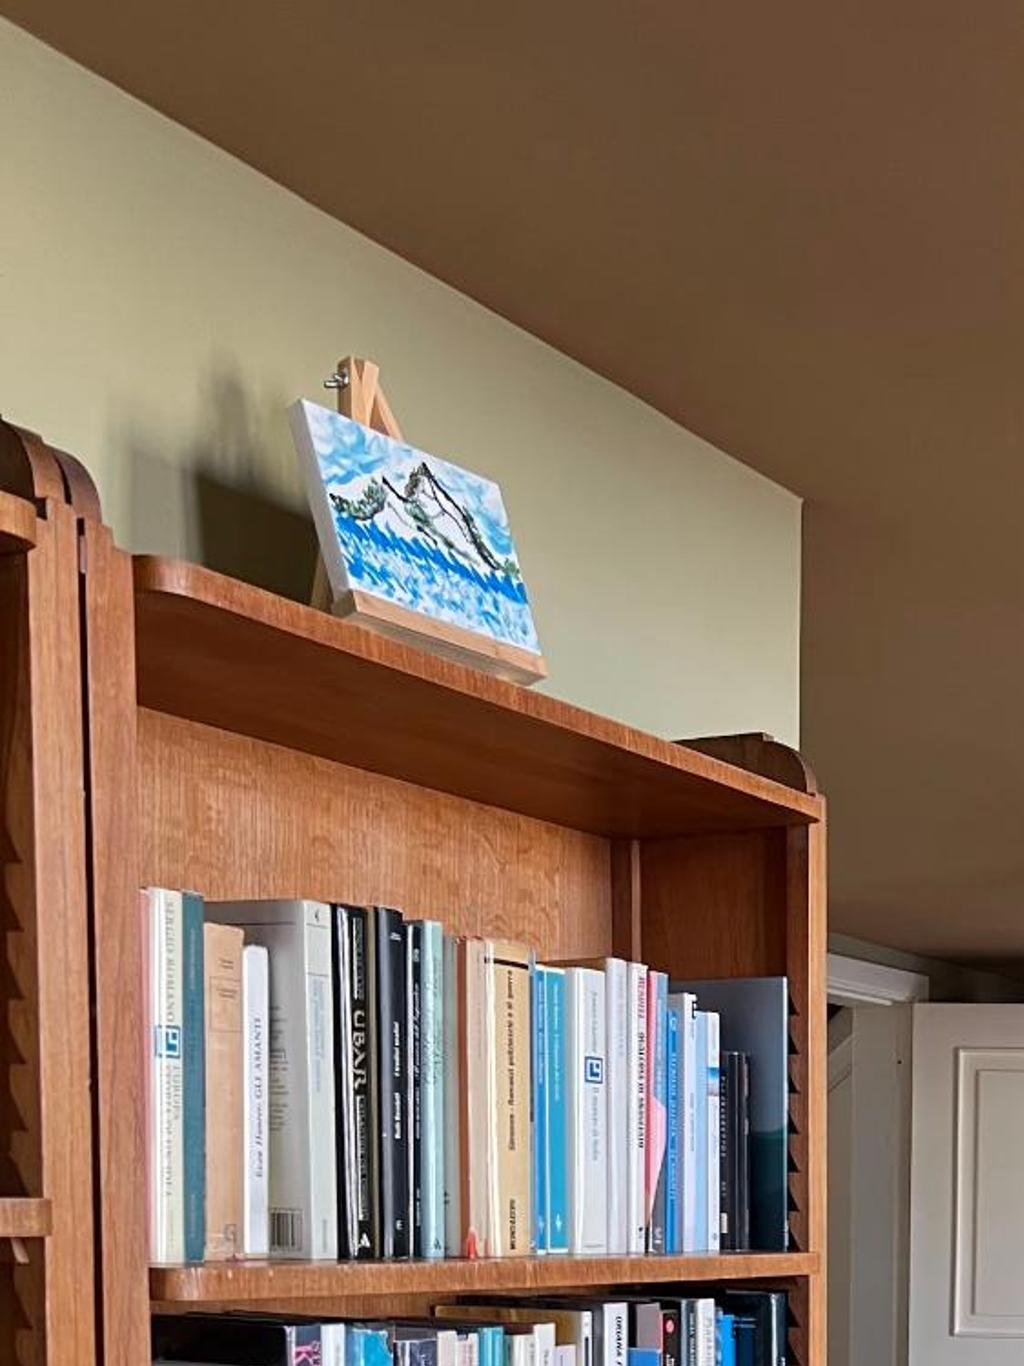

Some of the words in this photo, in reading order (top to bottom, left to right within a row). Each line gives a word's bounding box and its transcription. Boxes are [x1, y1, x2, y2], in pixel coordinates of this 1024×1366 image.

[254, 1017, 263, 1072] AMANTI
[352, 1009, 367, 1090] UBAR
[615, 1316, 623, 1357] ORIANA
